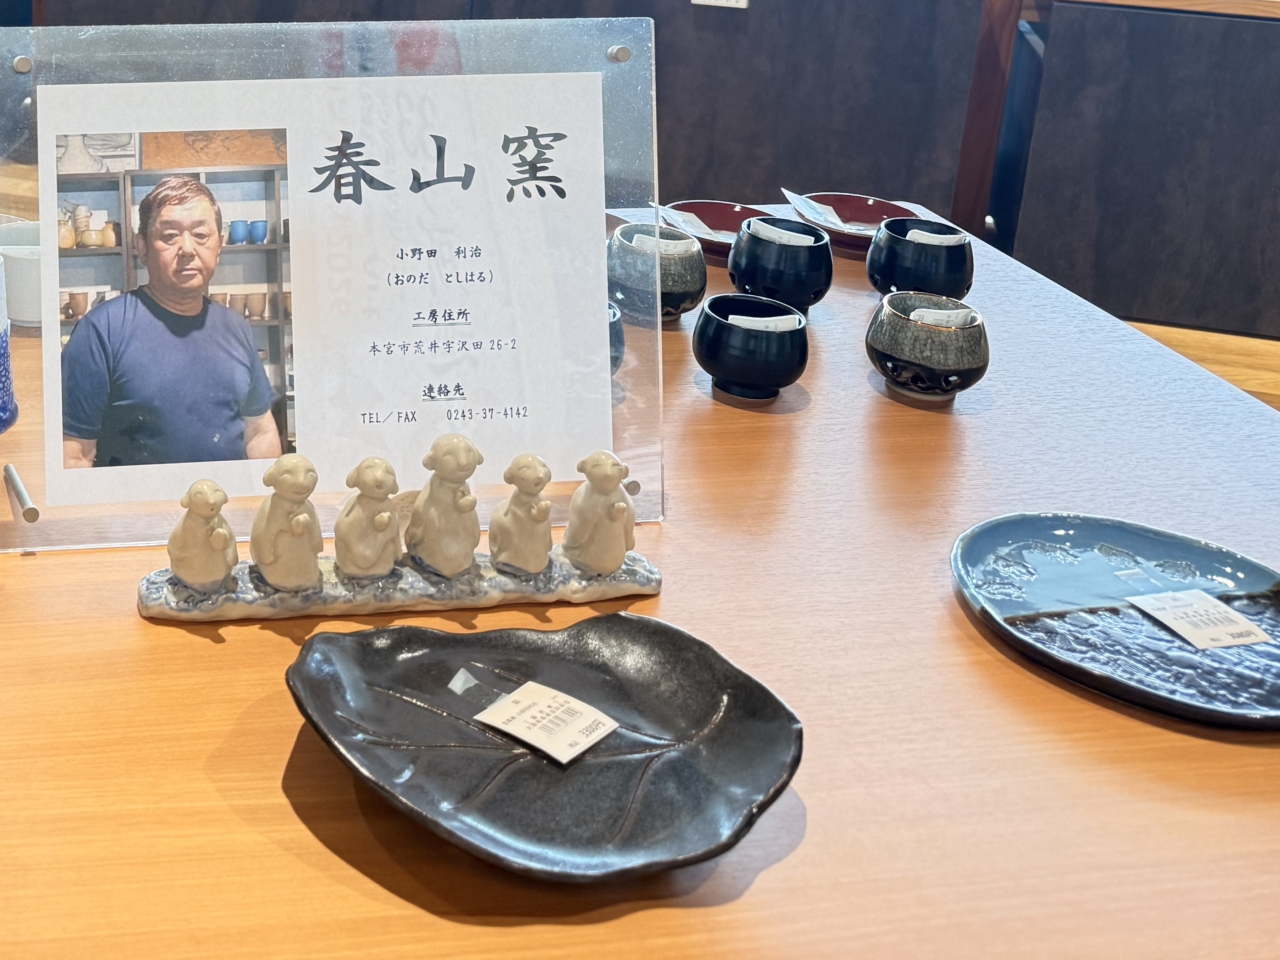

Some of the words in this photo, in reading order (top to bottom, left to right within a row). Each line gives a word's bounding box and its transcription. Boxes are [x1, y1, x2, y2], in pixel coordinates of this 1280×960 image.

[307, 125, 568, 206] 春山窯
[396, 247, 438, 261] 小野田
[454, 245, 483, 259] 利治
[387, 272, 429, 286] (おのだ
[445, 269, 495, 285] としはる)
[413, 308, 470, 324] 工房住所
[368, 340, 483, 356] 本宮市荒井字沢田
[489, 338, 518, 351] 26-2
[422, 383, 465, 399] 連絡先
[446, 406, 529, 421] 0243-37-4142
